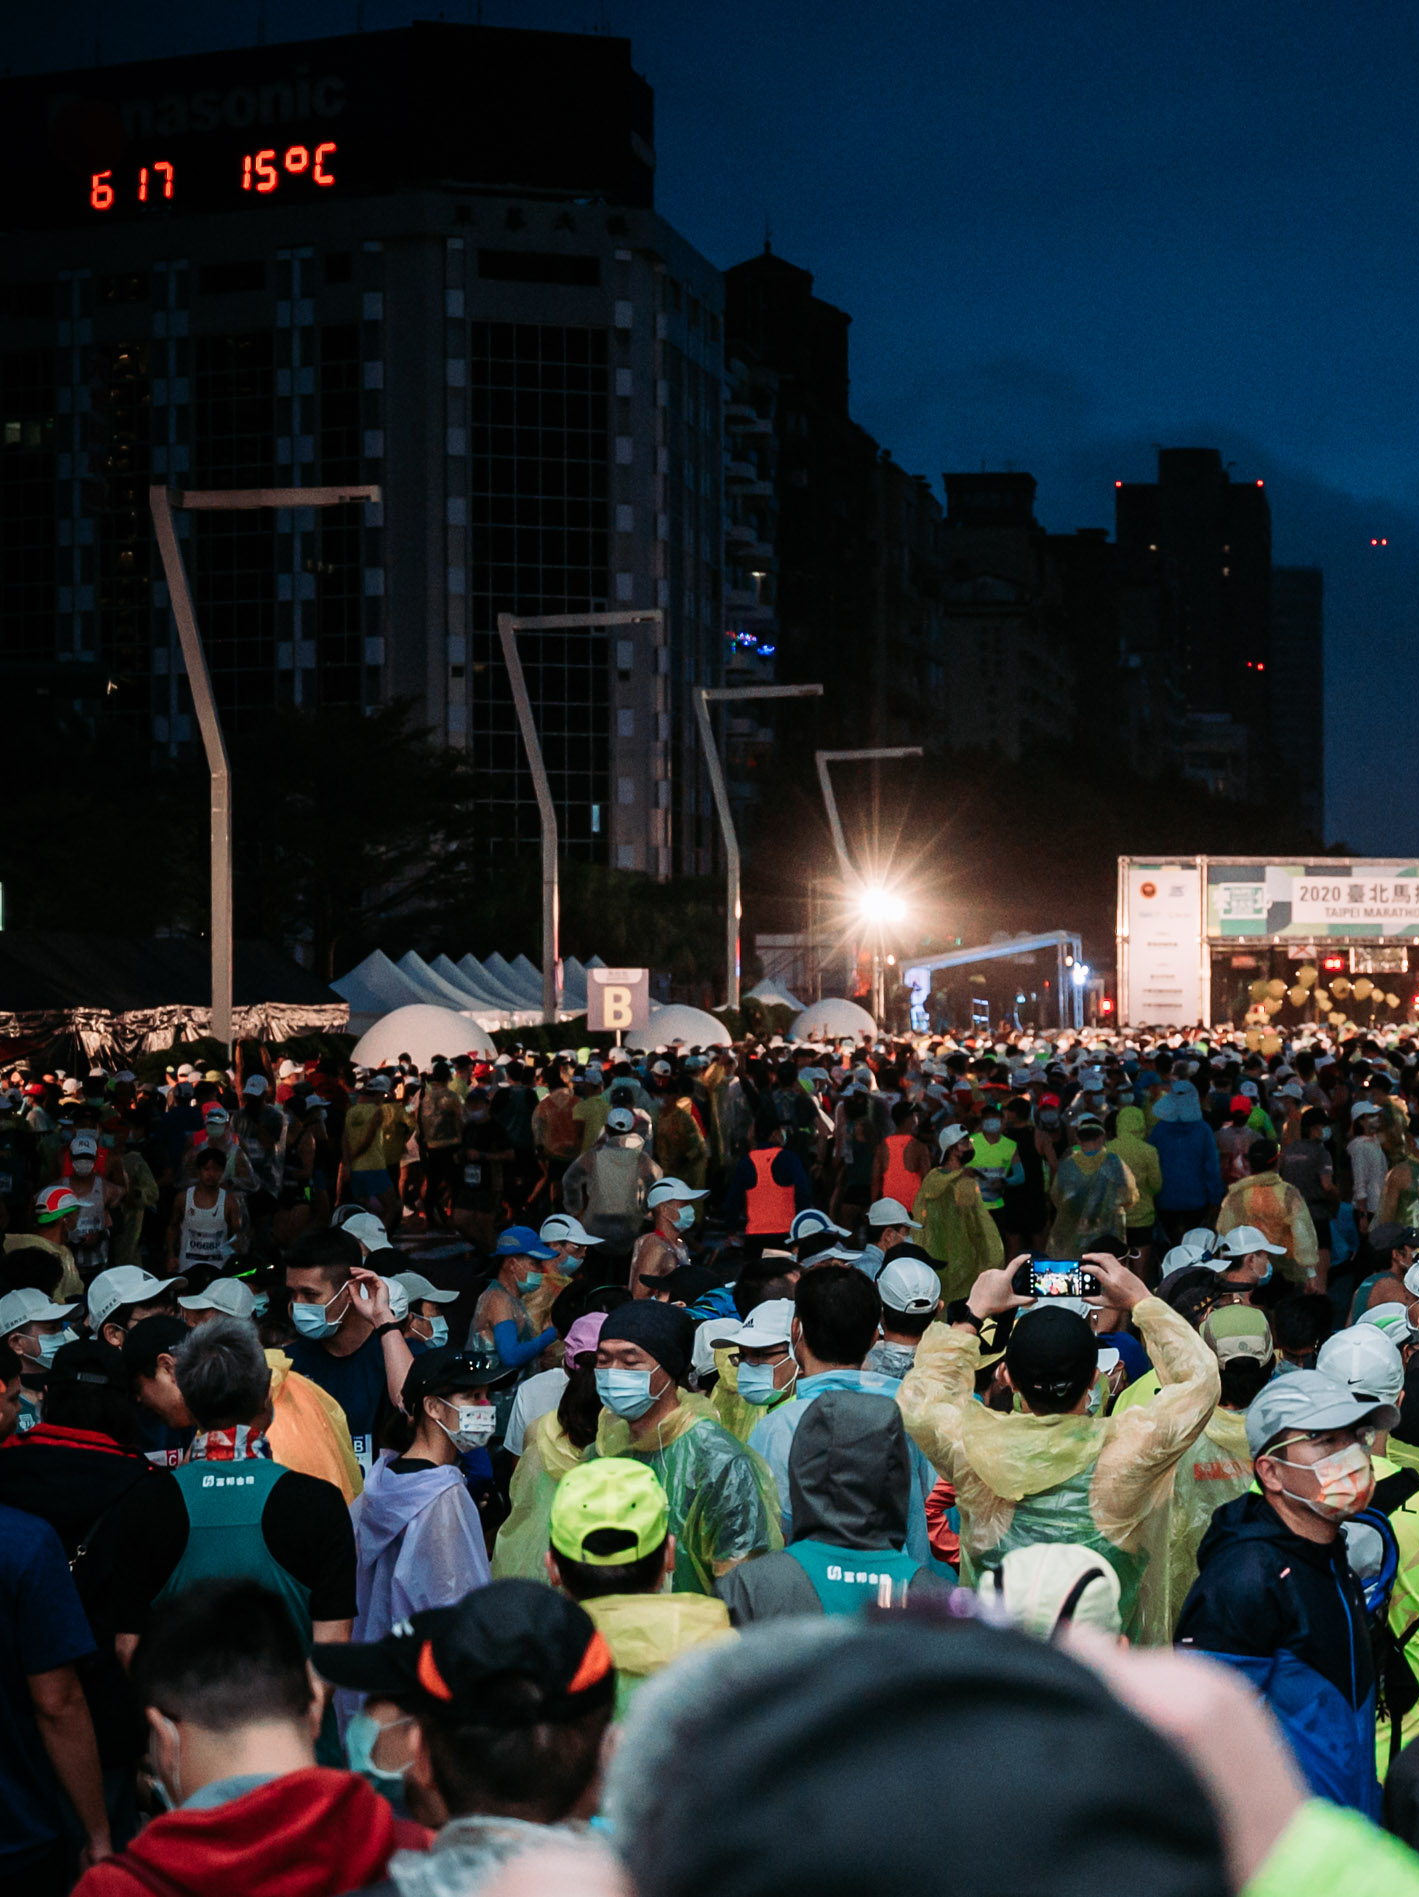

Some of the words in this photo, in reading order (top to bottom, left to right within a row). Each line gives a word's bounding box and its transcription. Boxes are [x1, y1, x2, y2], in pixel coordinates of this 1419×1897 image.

[90, 169, 113, 209] 6
[1299, 885, 1341, 902] 2020
[1325, 907, 1360, 918] TAIPEI
[603, 986, 633, 1028] B
